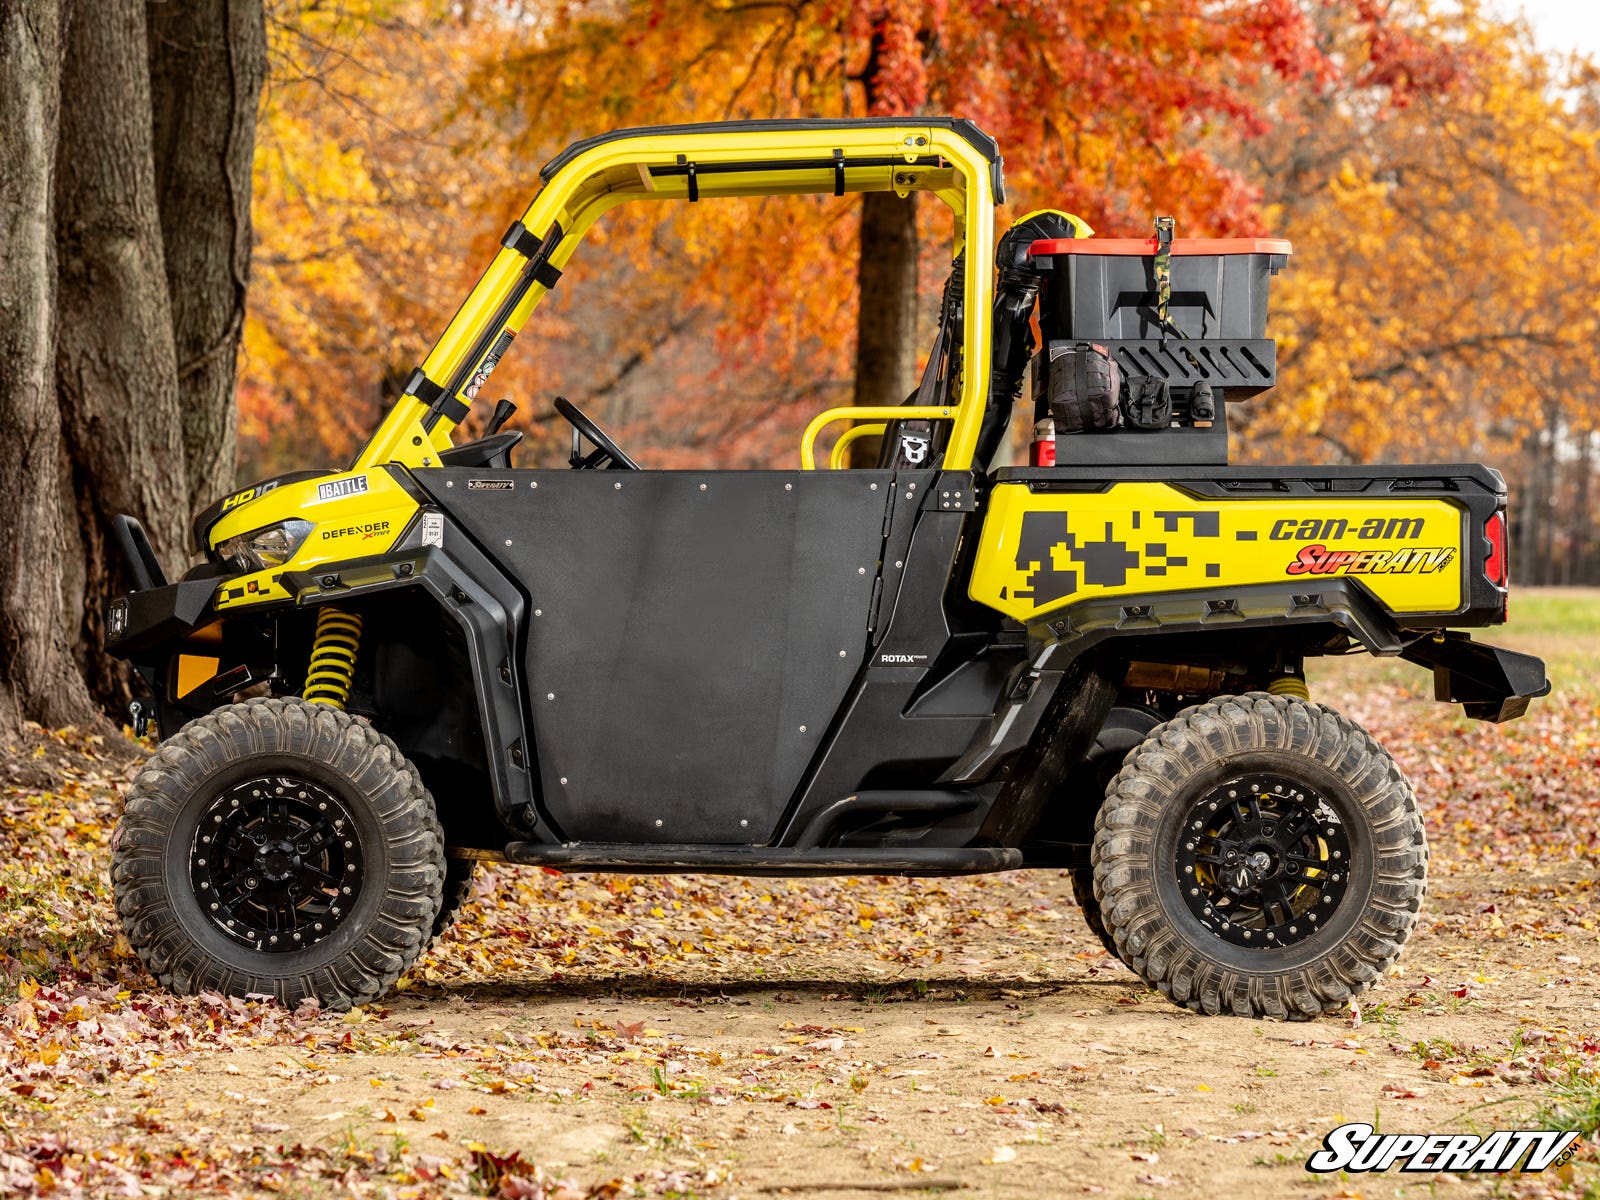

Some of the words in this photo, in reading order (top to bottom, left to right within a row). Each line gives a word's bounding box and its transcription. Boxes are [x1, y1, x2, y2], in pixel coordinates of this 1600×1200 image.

[222, 481, 278, 511] HD10
[325, 477, 366, 498] BATTLE
[322, 521, 390, 540] DEFENDER
[1269, 518, 1425, 540] can-am
[881, 654, 914, 663] ROTAX
